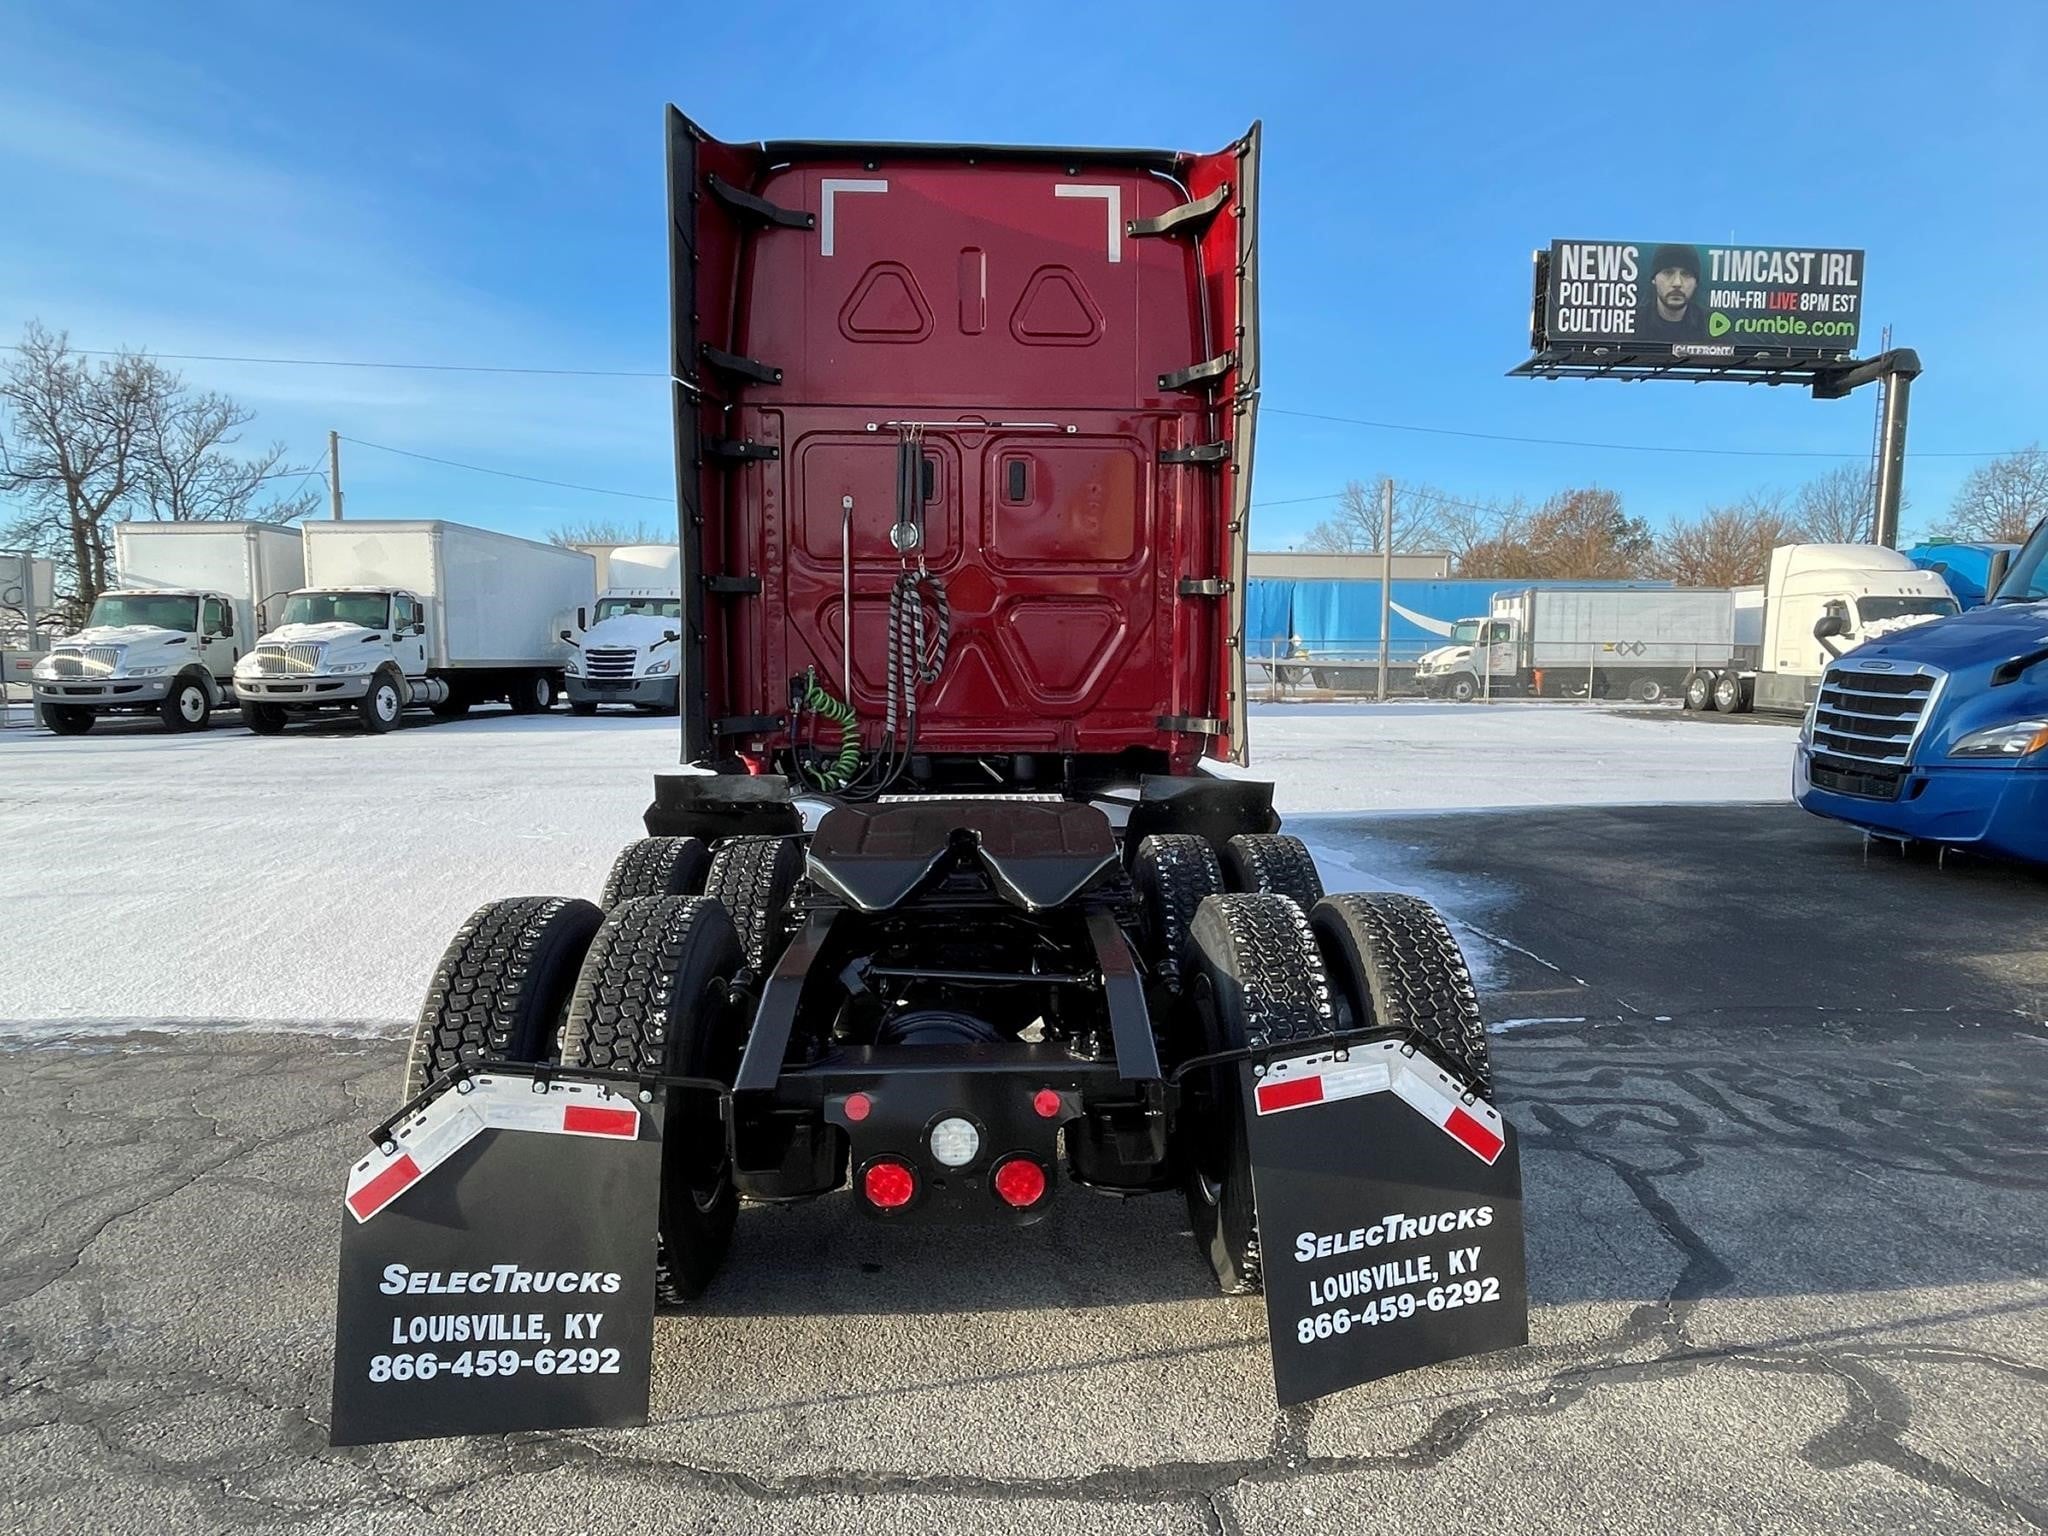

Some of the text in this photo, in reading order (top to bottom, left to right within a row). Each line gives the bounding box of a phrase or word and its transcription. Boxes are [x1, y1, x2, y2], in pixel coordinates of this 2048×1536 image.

[1561, 244, 1639, 281] NEWS
[1708, 250, 1858, 286] TIMCAST IRL
[1559, 281, 1638, 307] POLITICS
[1710, 290, 1857, 313] MON-FRI LIVE 8PM EST
[1558, 308, 1636, 334] CULTURE
[1734, 315, 1855, 337] rumble.com
[1310, 1246, 1481, 1307] LOUISVILLE, KY
[1297, 1277, 1501, 1345] 866-459-6292
[392, 1313, 603, 1345] LOUISVILLE, KY
[368, 1348, 621, 1383] 866-459-6292
